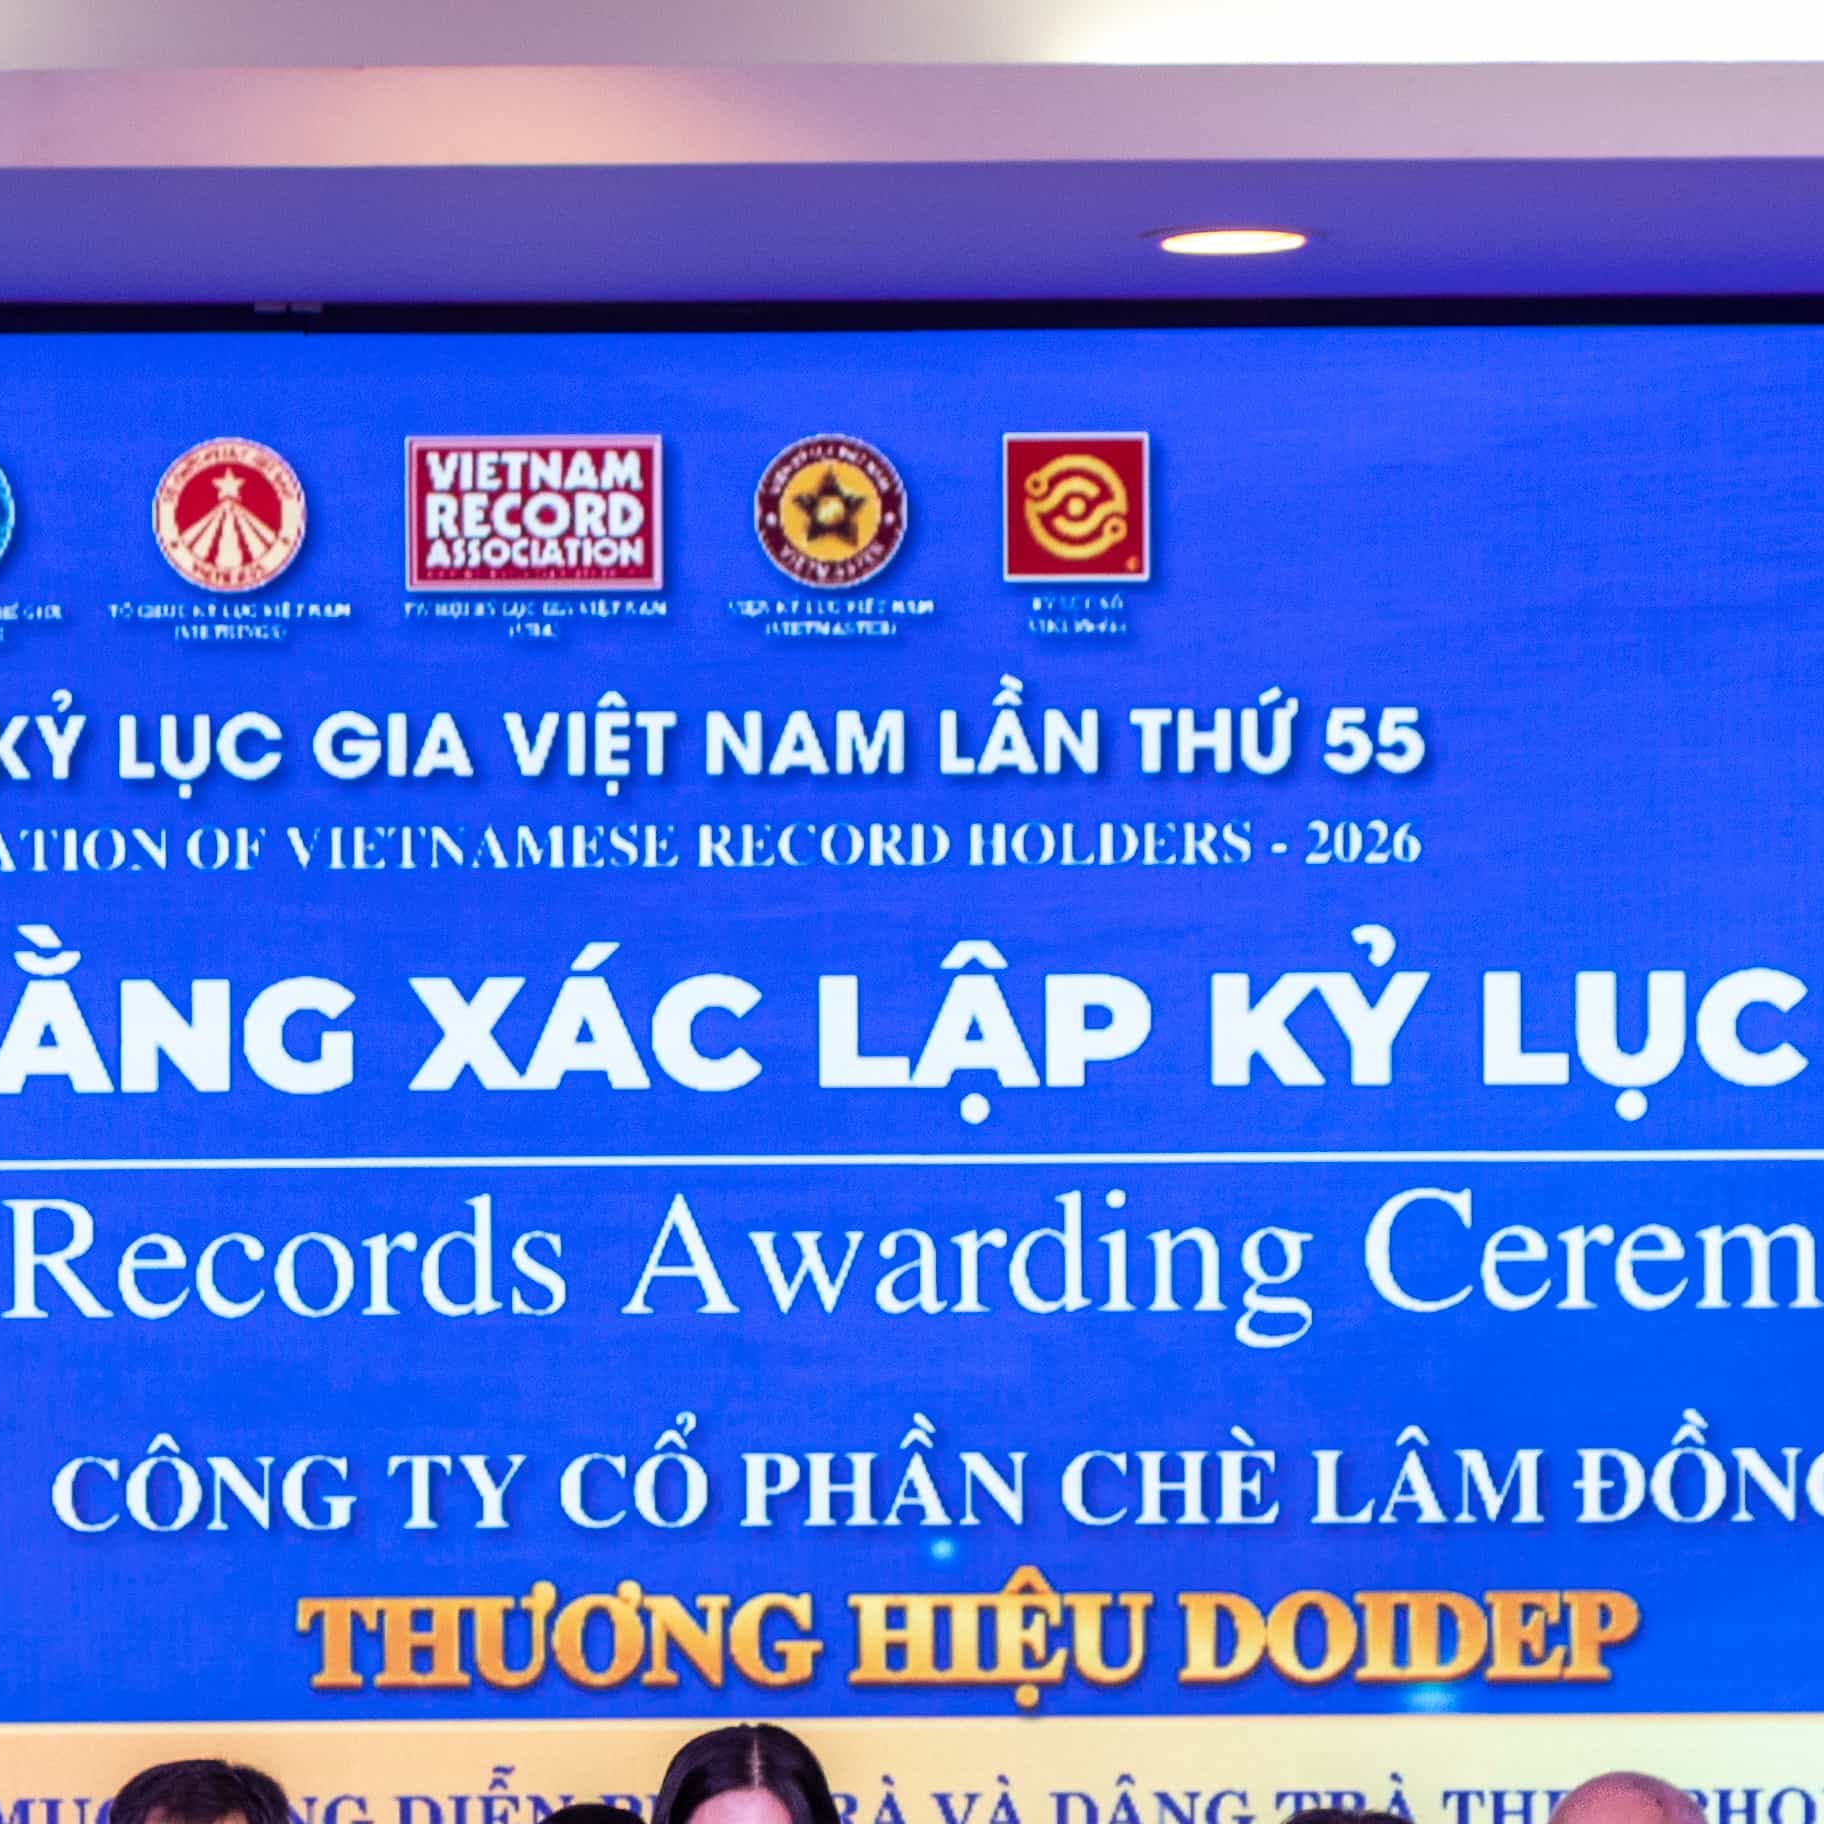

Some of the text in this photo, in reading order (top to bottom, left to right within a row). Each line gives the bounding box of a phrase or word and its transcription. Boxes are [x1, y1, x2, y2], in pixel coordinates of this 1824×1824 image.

[426, 450, 643, 492] VIETNAM
[426, 491, 645, 540] RECORD
[426, 538, 644, 569] ASSOCIATION
[119, 712, 282, 799] LỤC
[313, 711, 473, 779] GIA
[504, 691, 677, 796] VIỆT
[706, 710, 905, 775] NAM
[940, 674, 1099, 773] LẦN
[1129, 687, 1300, 774] THỨ
[1324, 707, 1425, 773] 55
[186, 827, 266, 870] OF
[287, 824, 679, 869] VIETNAMESE
[698, 823, 950, 868] RECORD
[969, 821, 1251, 866] HOLDERS
[1305, 819, 1422, 864] 2026
[409, 942, 762, 1091] XÁC
[819, 940, 1151, 1124] LẬP
[1212, 925, 1430, 1086] KỶ
[1483, 968, 1807, 1121] LỤC
[4, 1193, 566, 1319] Records
[622, 1189, 1313, 1348] Awarding
[52, 1433, 356, 1532] CÔNG
[388, 1454, 525, 1529] TY
[560, 1412, 707, 1528] CỔ
[741, 1413, 1025, 1526] PHẦN
[1062, 1426, 1279, 1525] CHÈ
[1312, 1425, 1543, 1523] LÂM
[297, 1565, 1638, 1707] THƯƠNG HIỆU DOIDEP
